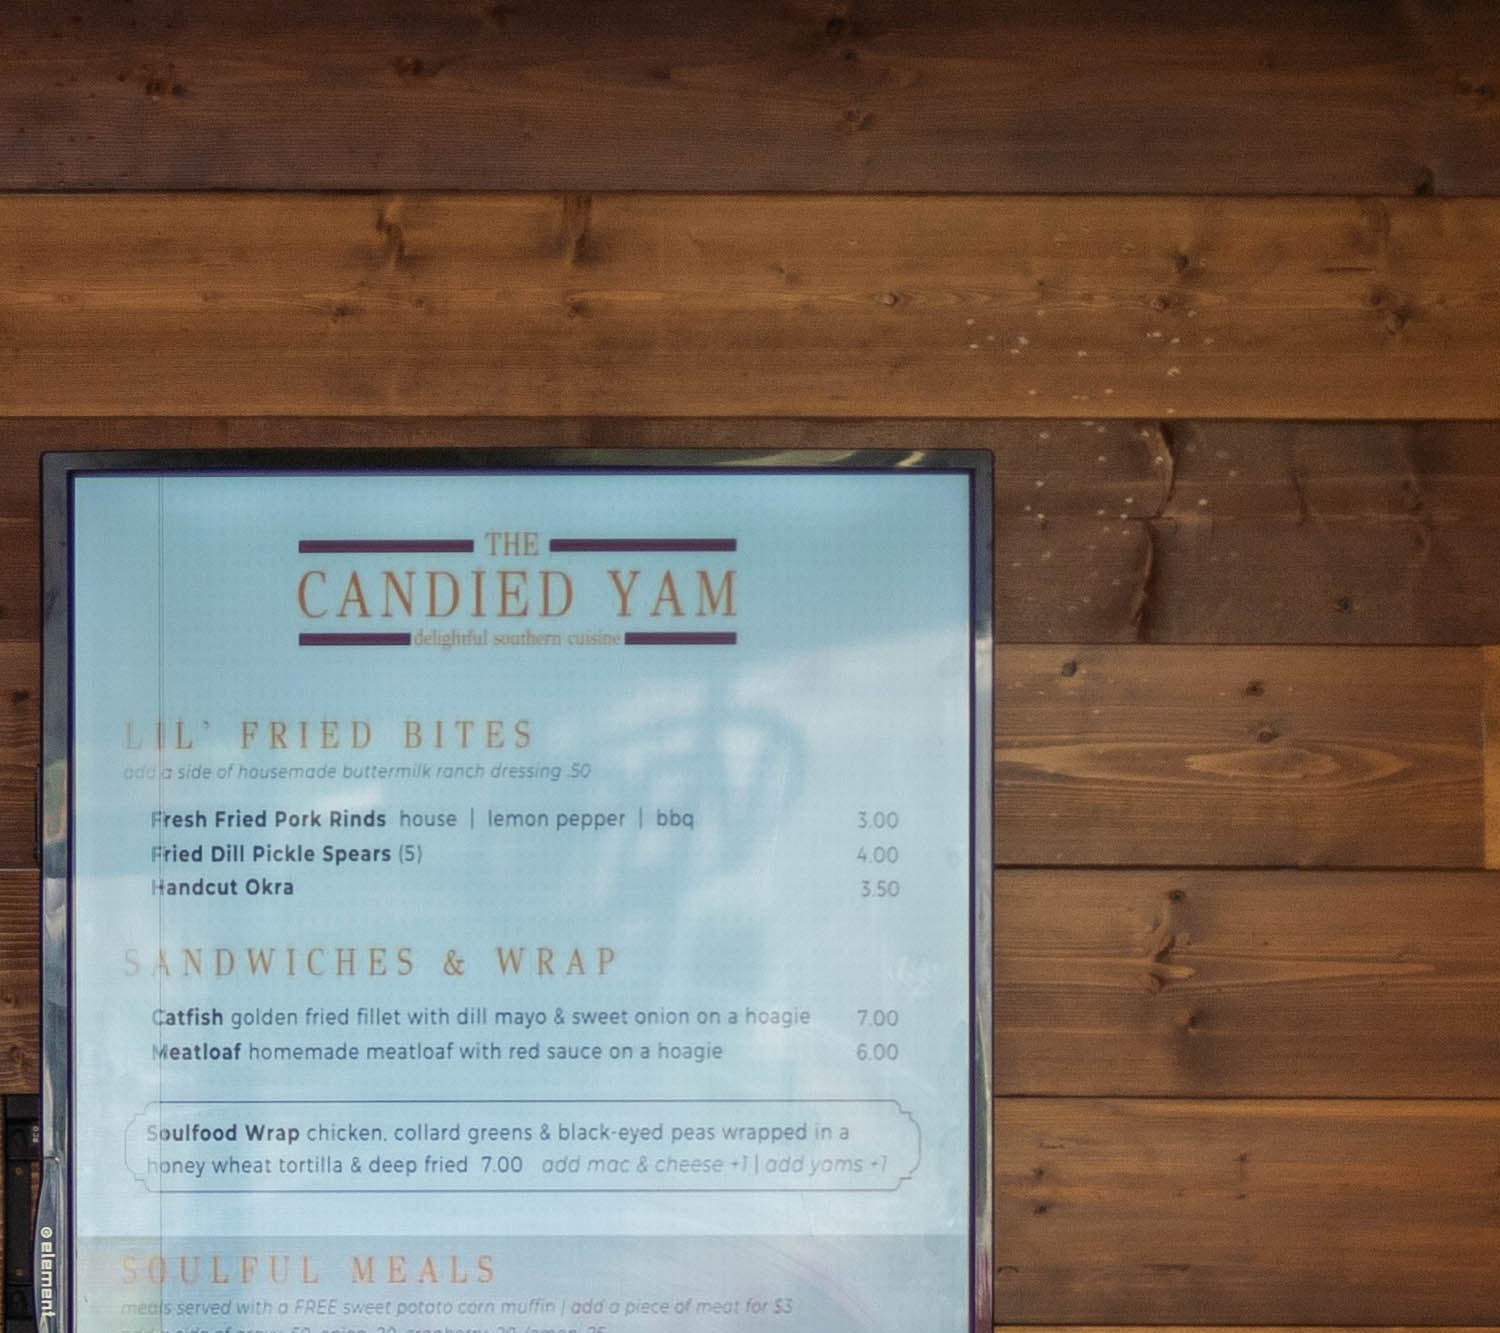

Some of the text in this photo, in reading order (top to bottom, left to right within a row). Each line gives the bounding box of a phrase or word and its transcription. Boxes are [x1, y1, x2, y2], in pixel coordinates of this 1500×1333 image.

[484, 531, 539, 557] THE
[297, 569, 737, 619] CANDIED YAM
[492, 629, 563, 647] southern
[241, 720, 372, 750] FRIED
[403, 718, 531, 749] BITES
[151, 808, 695, 832] Fresh Fried Pork Rinds house lemon pepper bbq
[857, 810, 900, 830] 3.00
[151, 843, 423, 867] Fried Dill Pickle Spears (5)
[856, 845, 900, 865] 4.00
[152, 877, 294, 896] Handcut Okra
[861, 879, 901, 899] 3.50
[124, 946, 616, 977] SANDWICHES & WRAP
[152, 1006, 811, 1030] Catfish golden fried fillet with dill mayo & sweet onion on a hoagie
[856, 1008, 900, 1028] 7.00
[147, 1123, 238, 1142] Soulfood
[244, 1124, 301, 1145] Wrap
[393, 1123, 461, 1142] collard
[467, 1127, 533, 1146] greens
[539, 1122, 551, 1142] &
[558, 1122, 664, 1146] black-eyed
[671, 1126, 716, 1145] peas
[721, 1122, 808, 1144] wrapped
[814, 1126, 833, 1140] in
[838, 1126, 850, 1141] a
[41, 1241, 56, 1317] element
[122, 1254, 494, 1285] SOULFUL MEALS
